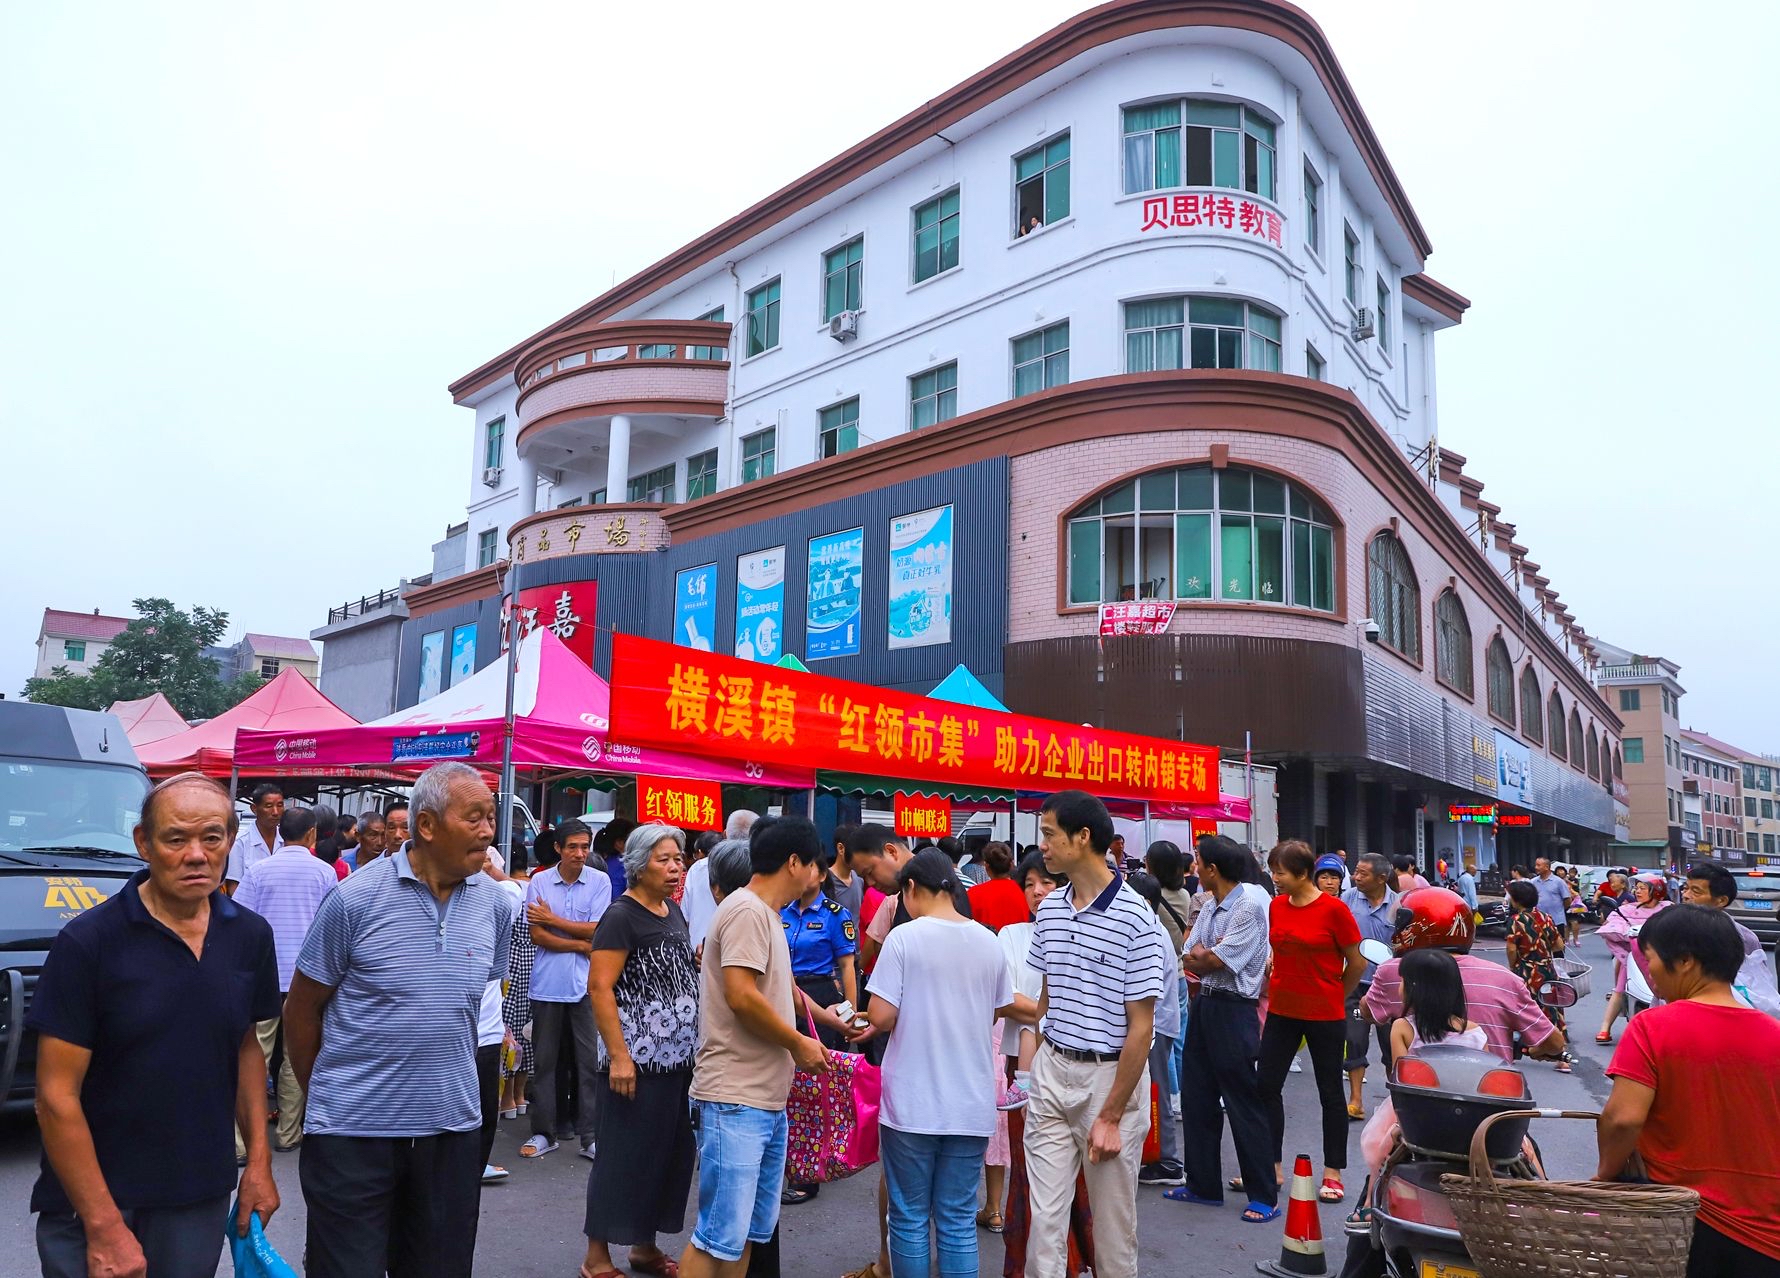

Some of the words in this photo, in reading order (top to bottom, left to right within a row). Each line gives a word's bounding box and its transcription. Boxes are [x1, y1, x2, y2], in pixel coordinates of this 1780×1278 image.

[1141, 194, 1282, 249] 贝思特教育
[508, 514, 631, 570] 商品市場
[288, 738, 318, 750] 中国移动
[665, 663, 797, 746] 横溪镇
[819, 692, 980, 769] “红领市集”
[993, 725, 1206, 792] 助力企业出口转内销专场
[289, 751, 301, 760] China
[301, 750, 318, 760] Mobile
[645, 786, 717, 825] 红领服务
[901, 806, 947, 833] 巾帼联动
